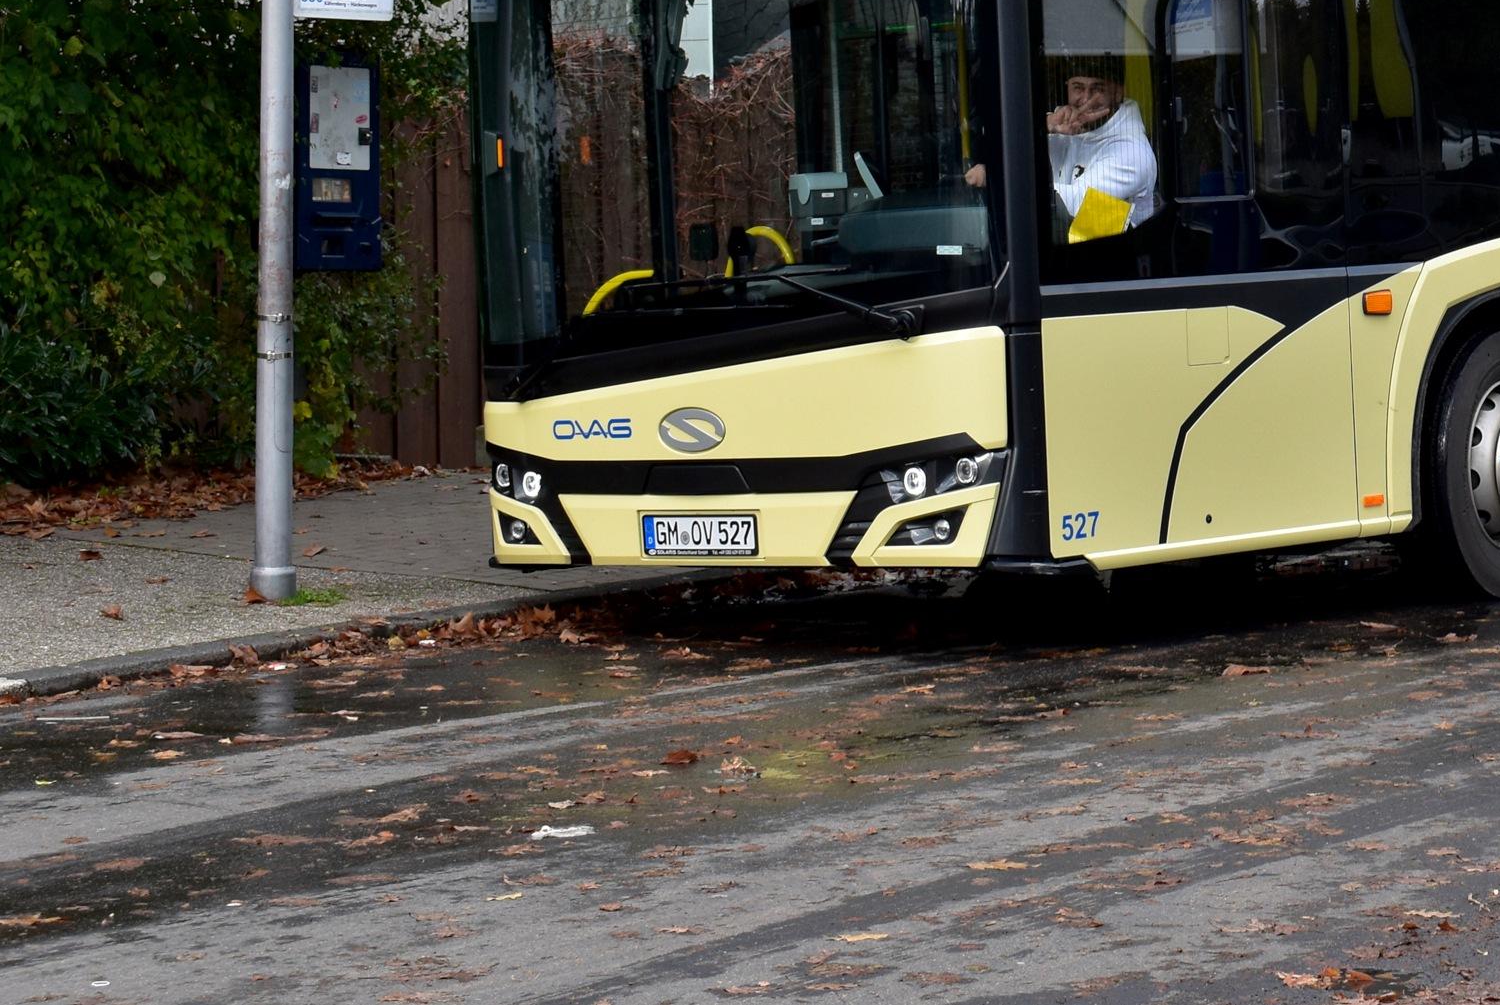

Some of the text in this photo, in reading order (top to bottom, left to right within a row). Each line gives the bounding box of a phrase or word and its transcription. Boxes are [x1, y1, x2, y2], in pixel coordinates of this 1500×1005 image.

[553, 418, 632, 440] OVAG
[655, 520, 752, 545] GM OV 527
[1062, 511, 1099, 541] 527
